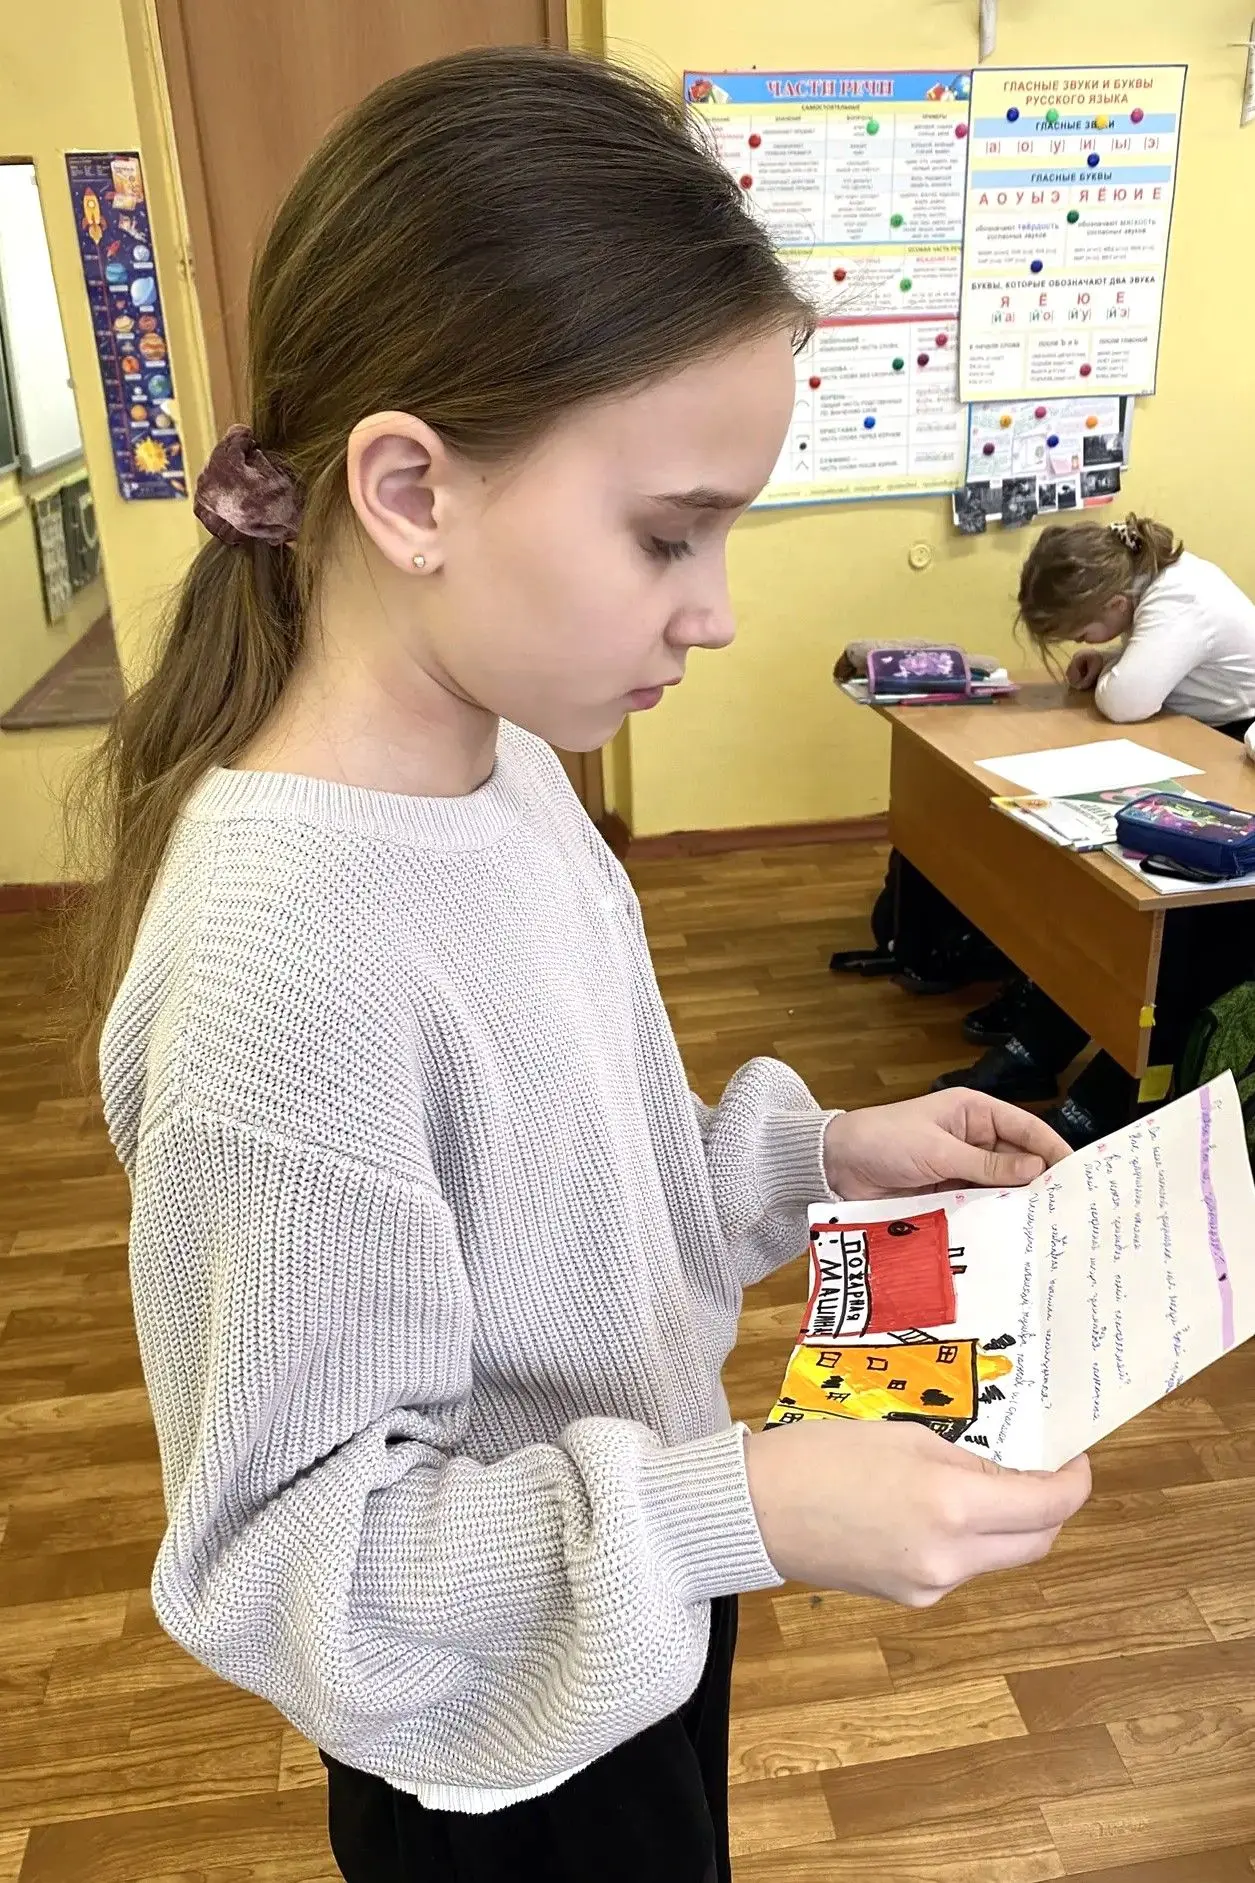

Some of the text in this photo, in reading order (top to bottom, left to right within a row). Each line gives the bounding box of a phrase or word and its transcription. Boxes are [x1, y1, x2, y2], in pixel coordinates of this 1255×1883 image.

[766, 79, 894, 98] ЧАСТИ РЕЧИ
[1003, 79, 1154, 91] ГЛАСНЫЕ ЗВУКИ И БУКВЫ
[1025, 93, 1128, 106] РУССКОГО ЯЗЫКА
[1035, 120, 1115, 131] ГЛАСНЫЕ ЗВИ
[1031, 172, 1112, 183] ГЛАСНЫЕ БУКВЫ
[979, 191, 1060, 205] А О У Ы Э
[1079, 188, 1161, 202] Я Ё Ю И Е
[971, 276, 1156, 290] БУКВЫ, КОТОРЫЕ ОБОЗНАЧАЮТ ДВА ЗВУКА
[1000, 292, 1125, 308] Я Ё Ю Е
[844, 1240, 866, 1321] ПОЖАРНАЯ
